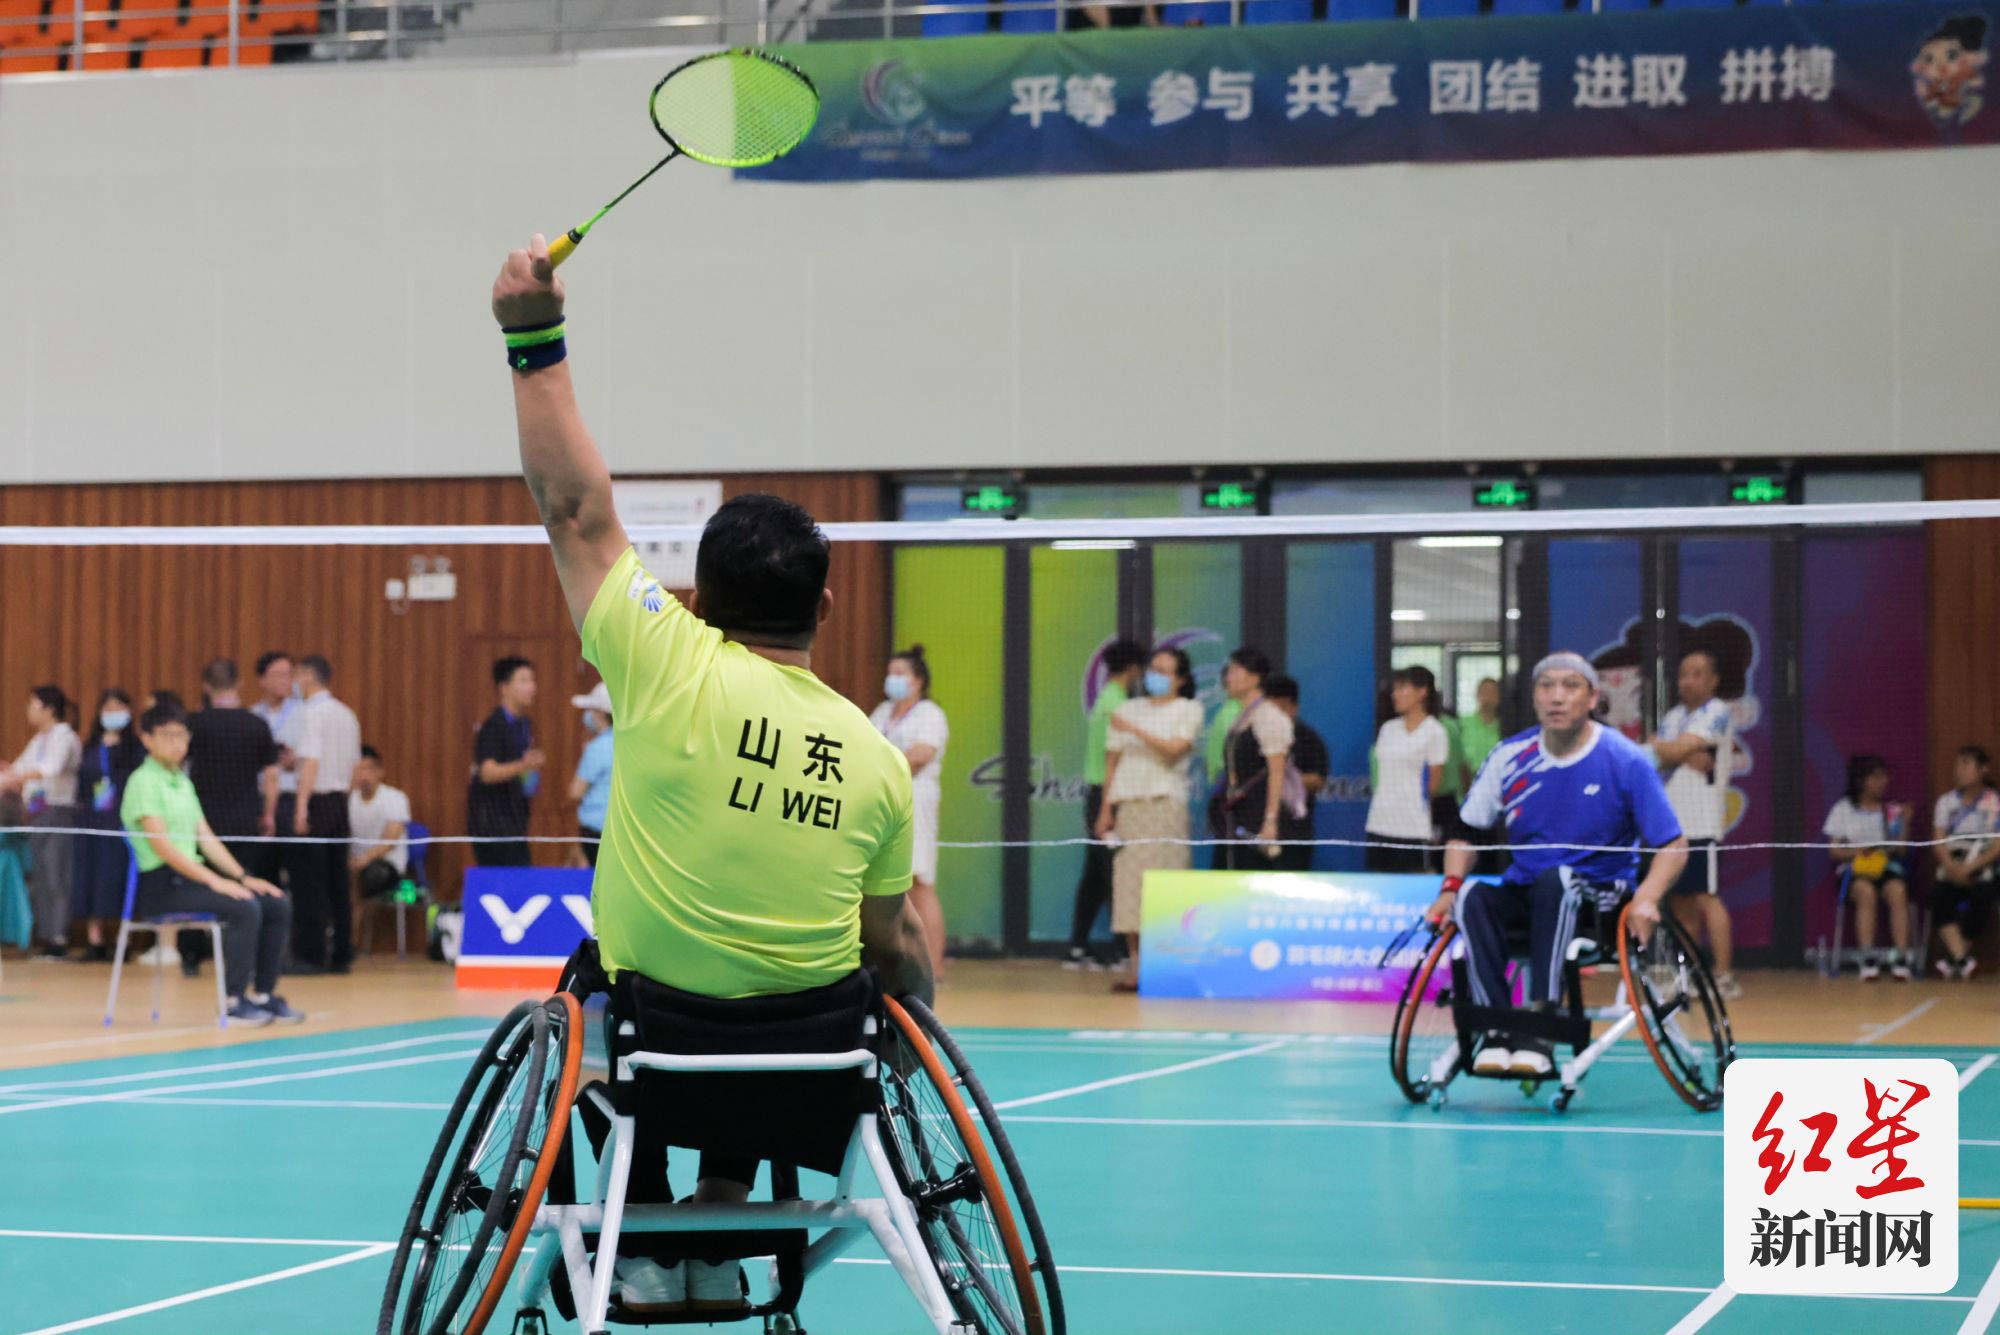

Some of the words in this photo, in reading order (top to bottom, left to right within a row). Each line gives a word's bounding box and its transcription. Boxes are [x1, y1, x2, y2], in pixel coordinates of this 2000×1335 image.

[1010, 73, 1117, 128] 平等
[1149, 69, 1255, 126] 参与
[1286, 64, 1397, 119] 共享
[1429, 57, 1541, 115] 团结
[1574, 54, 1687, 109] 进取
[1720, 45, 1836, 103] 拼搏
[737, 717, 843, 784] 山东
[728, 776, 764, 813] LI
[782, 787, 842, 831] WEI
